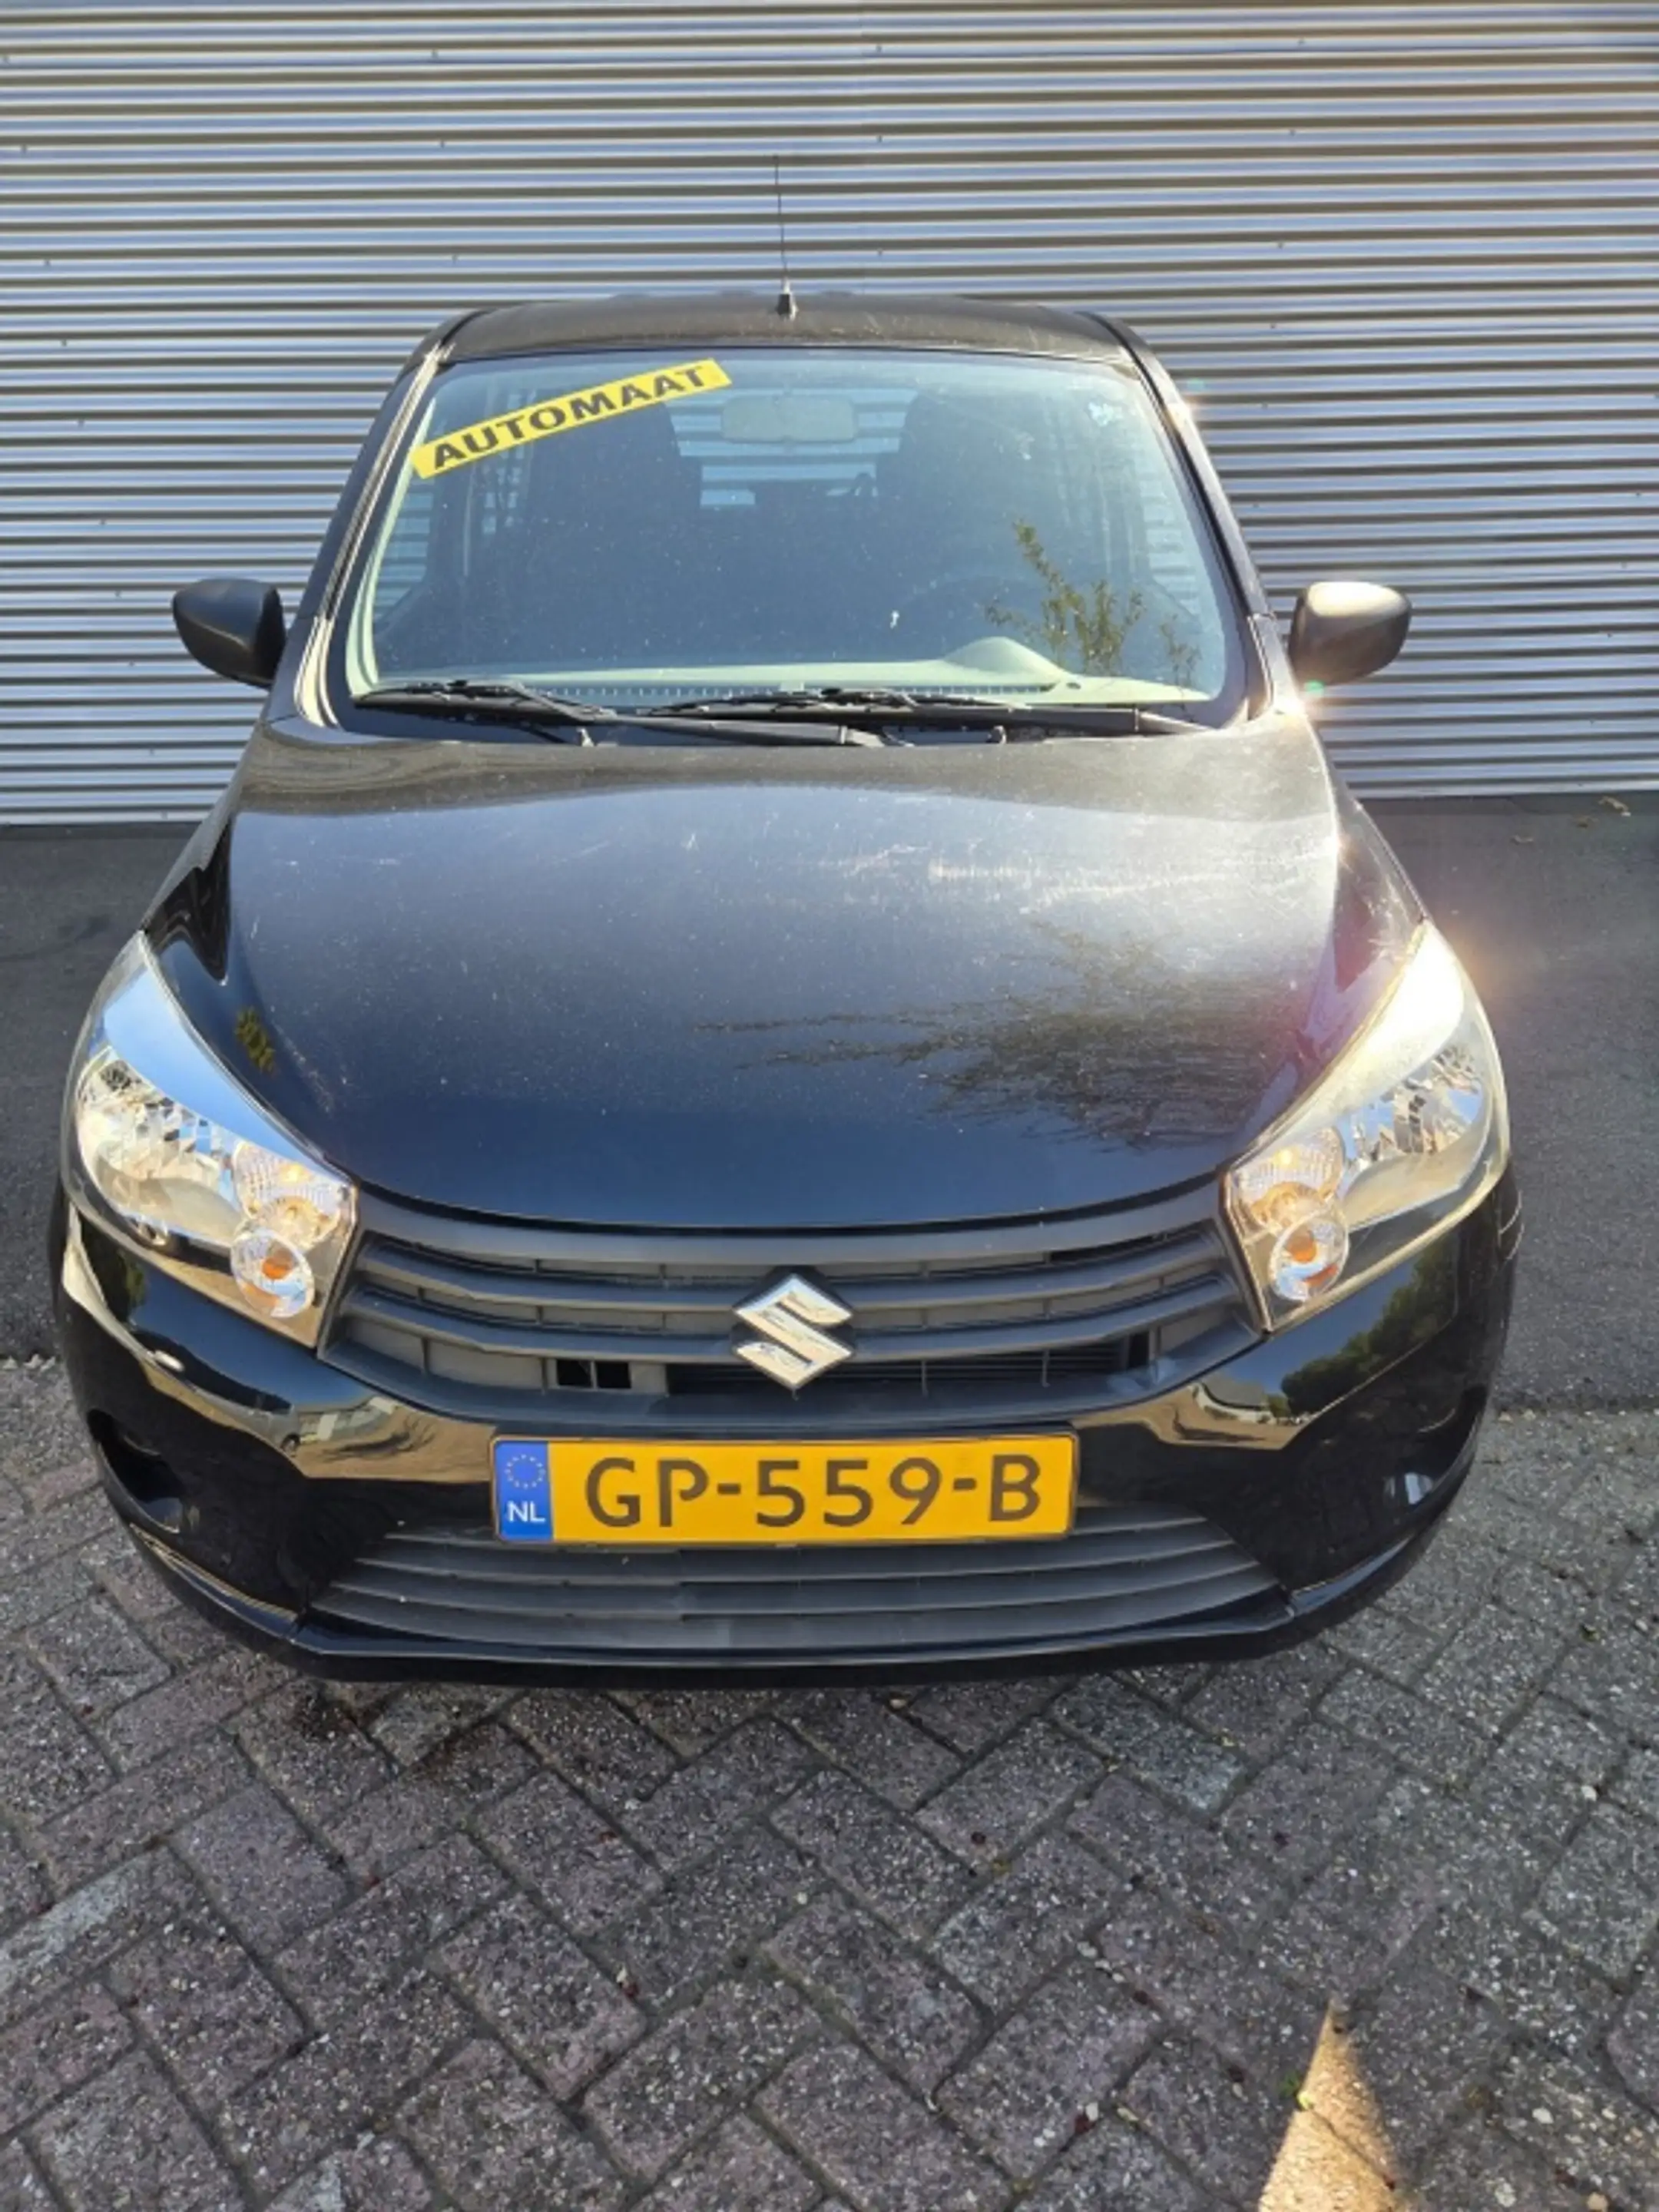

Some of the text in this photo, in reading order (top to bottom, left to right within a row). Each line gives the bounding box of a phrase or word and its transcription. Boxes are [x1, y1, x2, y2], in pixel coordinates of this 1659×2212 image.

[433, 366, 704, 470] AUTOMAAT
[506, 1500, 545, 1522] NL
[584, 1454, 1041, 1528] GP-559-B
